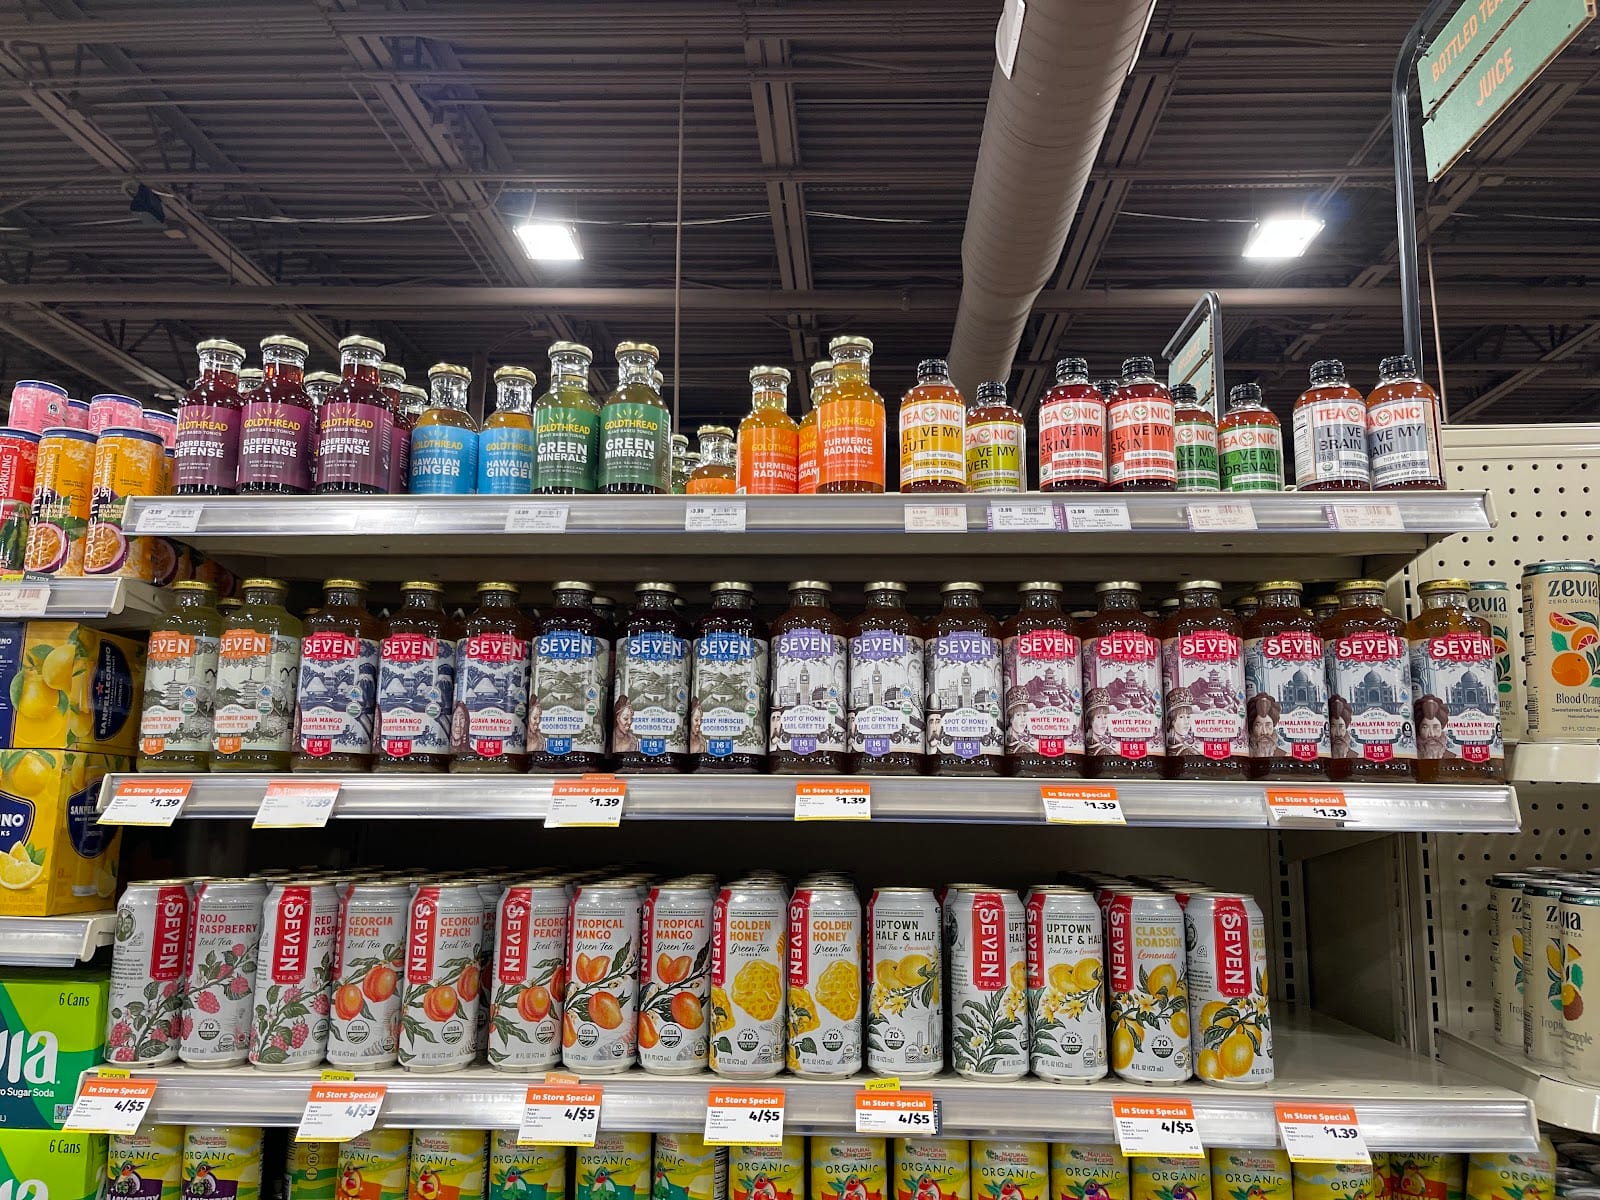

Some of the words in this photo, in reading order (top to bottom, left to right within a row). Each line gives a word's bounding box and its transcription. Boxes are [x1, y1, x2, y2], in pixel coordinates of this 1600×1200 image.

[1431, 14, 1479, 82] BOTTLED
[1477, 48, 1514, 107] JUICE
[244, 418, 300, 430] GOLDTHREAD
[244, 438, 297, 448] ELDERBERRY
[605, 438, 655, 451] GREEN
[824, 437, 872, 447] TURMERIC
[903, 440, 926, 454] GUT
[1041, 438, 1070, 455] SKIN
[175, 447, 224, 458] DEFENSE
[243, 445, 296, 457] DEFENSE
[320, 444, 370, 456] DEFENSE
[537, 442, 588, 454] GREEN
[824, 446, 872, 456] RADIANCE
[537, 453, 587, 464] MINERALS
[605, 449, 655, 460] MINERALS
[412, 458, 460, 467] HAWAIIAN
[754, 462, 797, 471] TURMERIC
[412, 465, 460, 476] GINGER
[753, 469, 797, 481] RADIANCE
[1220, 462, 1279, 477] ADRENALS
[1467, 597, 1507, 612] evia
[304, 640, 356, 655] SEVEN
[383, 641, 434, 656] SEVEN
[469, 640, 522, 657] SEVEN
[540, 639, 592, 654] SEVEN
[630, 640, 682, 656] SEVEN
[700, 640, 750, 655] SEVEN
[780, 637, 831, 653] SEVEN
[854, 638, 904, 654] SEVEN
[938, 640, 991, 656] SEVEN
[1020, 638, 1074, 654] SEVEN
[1100, 640, 1154, 656] SEVEN
[1182, 639, 1237, 655] SEVEN
[1268, 640, 1321, 655] SEVEN
[1339, 640, 1399, 656] SEVEN
[1433, 639, 1491, 656] SEVEN
[100, 646, 111, 735] SANPELLEGRINO
[1556, 693, 1581, 703] Blood
[156, 787, 183, 795] Special
[150, 798, 180, 807] $1.39
[590, 797, 620, 807] $1.39
[1084, 801, 1116, 810] $1.39
[200, 914, 226, 923] ROJO
[315, 916, 332, 925] RED
[350, 917, 393, 926] GEORGIA
[577, 920, 624, 928] TROPICAL
[657, 920, 704, 928] TROPICAL
[200, 923, 257, 934] RASPBERRY
[730, 920, 771, 930] GOLDEN
[813, 921, 852, 930] GOLDEN
[876, 920, 919, 930] UPTOWN
[1047, 924, 1091, 934] UPTOWN
[159, 903, 183, 969] SEVEN
[349, 928, 379, 937] PEACH
[440, 928, 471, 938] PEACH
[576, 930, 611, 939] MANGO
[656, 930, 692, 939] MANGO
[876, 931, 898, 940] HALF
[902, 932, 910, 941] &
[915, 931, 935, 941] HALF
[1136, 926, 1176, 936] CLASSIC
[217, 938, 233, 946] Tea
[280, 903, 303, 972] SEVEN
[412, 903, 430, 972] SEVEN
[504, 904, 525, 972] SEVEN
[730, 932, 765, 942] HONEY
[813, 932, 847, 942] HONEY
[576, 942, 598, 952] Green
[600, 942, 613, 951] Tea
[980, 908, 999, 978] SEVEN
[1136, 938, 1182, 948] ROADSIDE
[1222, 914, 1245, 984] SEVEN
[1136, 951, 1177, 960] Lemonade
[59, 993, 64, 1006] 6
[67, 993, 90, 1007] Cans
[204, 1022, 214, 1030] 70
[7, 1088, 31, 1098] Sugar
[33, 1088, 54, 1097] Soda
[120, 1087, 148, 1095] Special
[349, 1092, 378, 1100] Special
[114, 1100, 144, 1113] 4/$5
[749, 1097, 778, 1106] Special
[897, 1100, 926, 1109] Special
[564, 1107, 595, 1122] 4/$5
[749, 1110, 780, 1123] 4/$5
[899, 1113, 930, 1125] 4/$5
[1323, 1126, 1357, 1138] $1.39
[50, 1139, 55, 1152] 6
[58, 1140, 80, 1154] Cans
[110, 1151, 159, 1161] ORGANIC
[185, 1151, 235, 1162] ORGANIC
[494, 1156, 544, 1165] ORGANIC
[582, 1156, 632, 1166] ORGANIC
[738, 1162, 790, 1173] ORGANIC
[826, 1165, 879, 1174] ORGANIC
[902, 1162, 954, 1175] ORGANIC
[982, 1167, 1036, 1179] ORGANIC
[1066, 1167, 1120, 1180] ORGANIC
